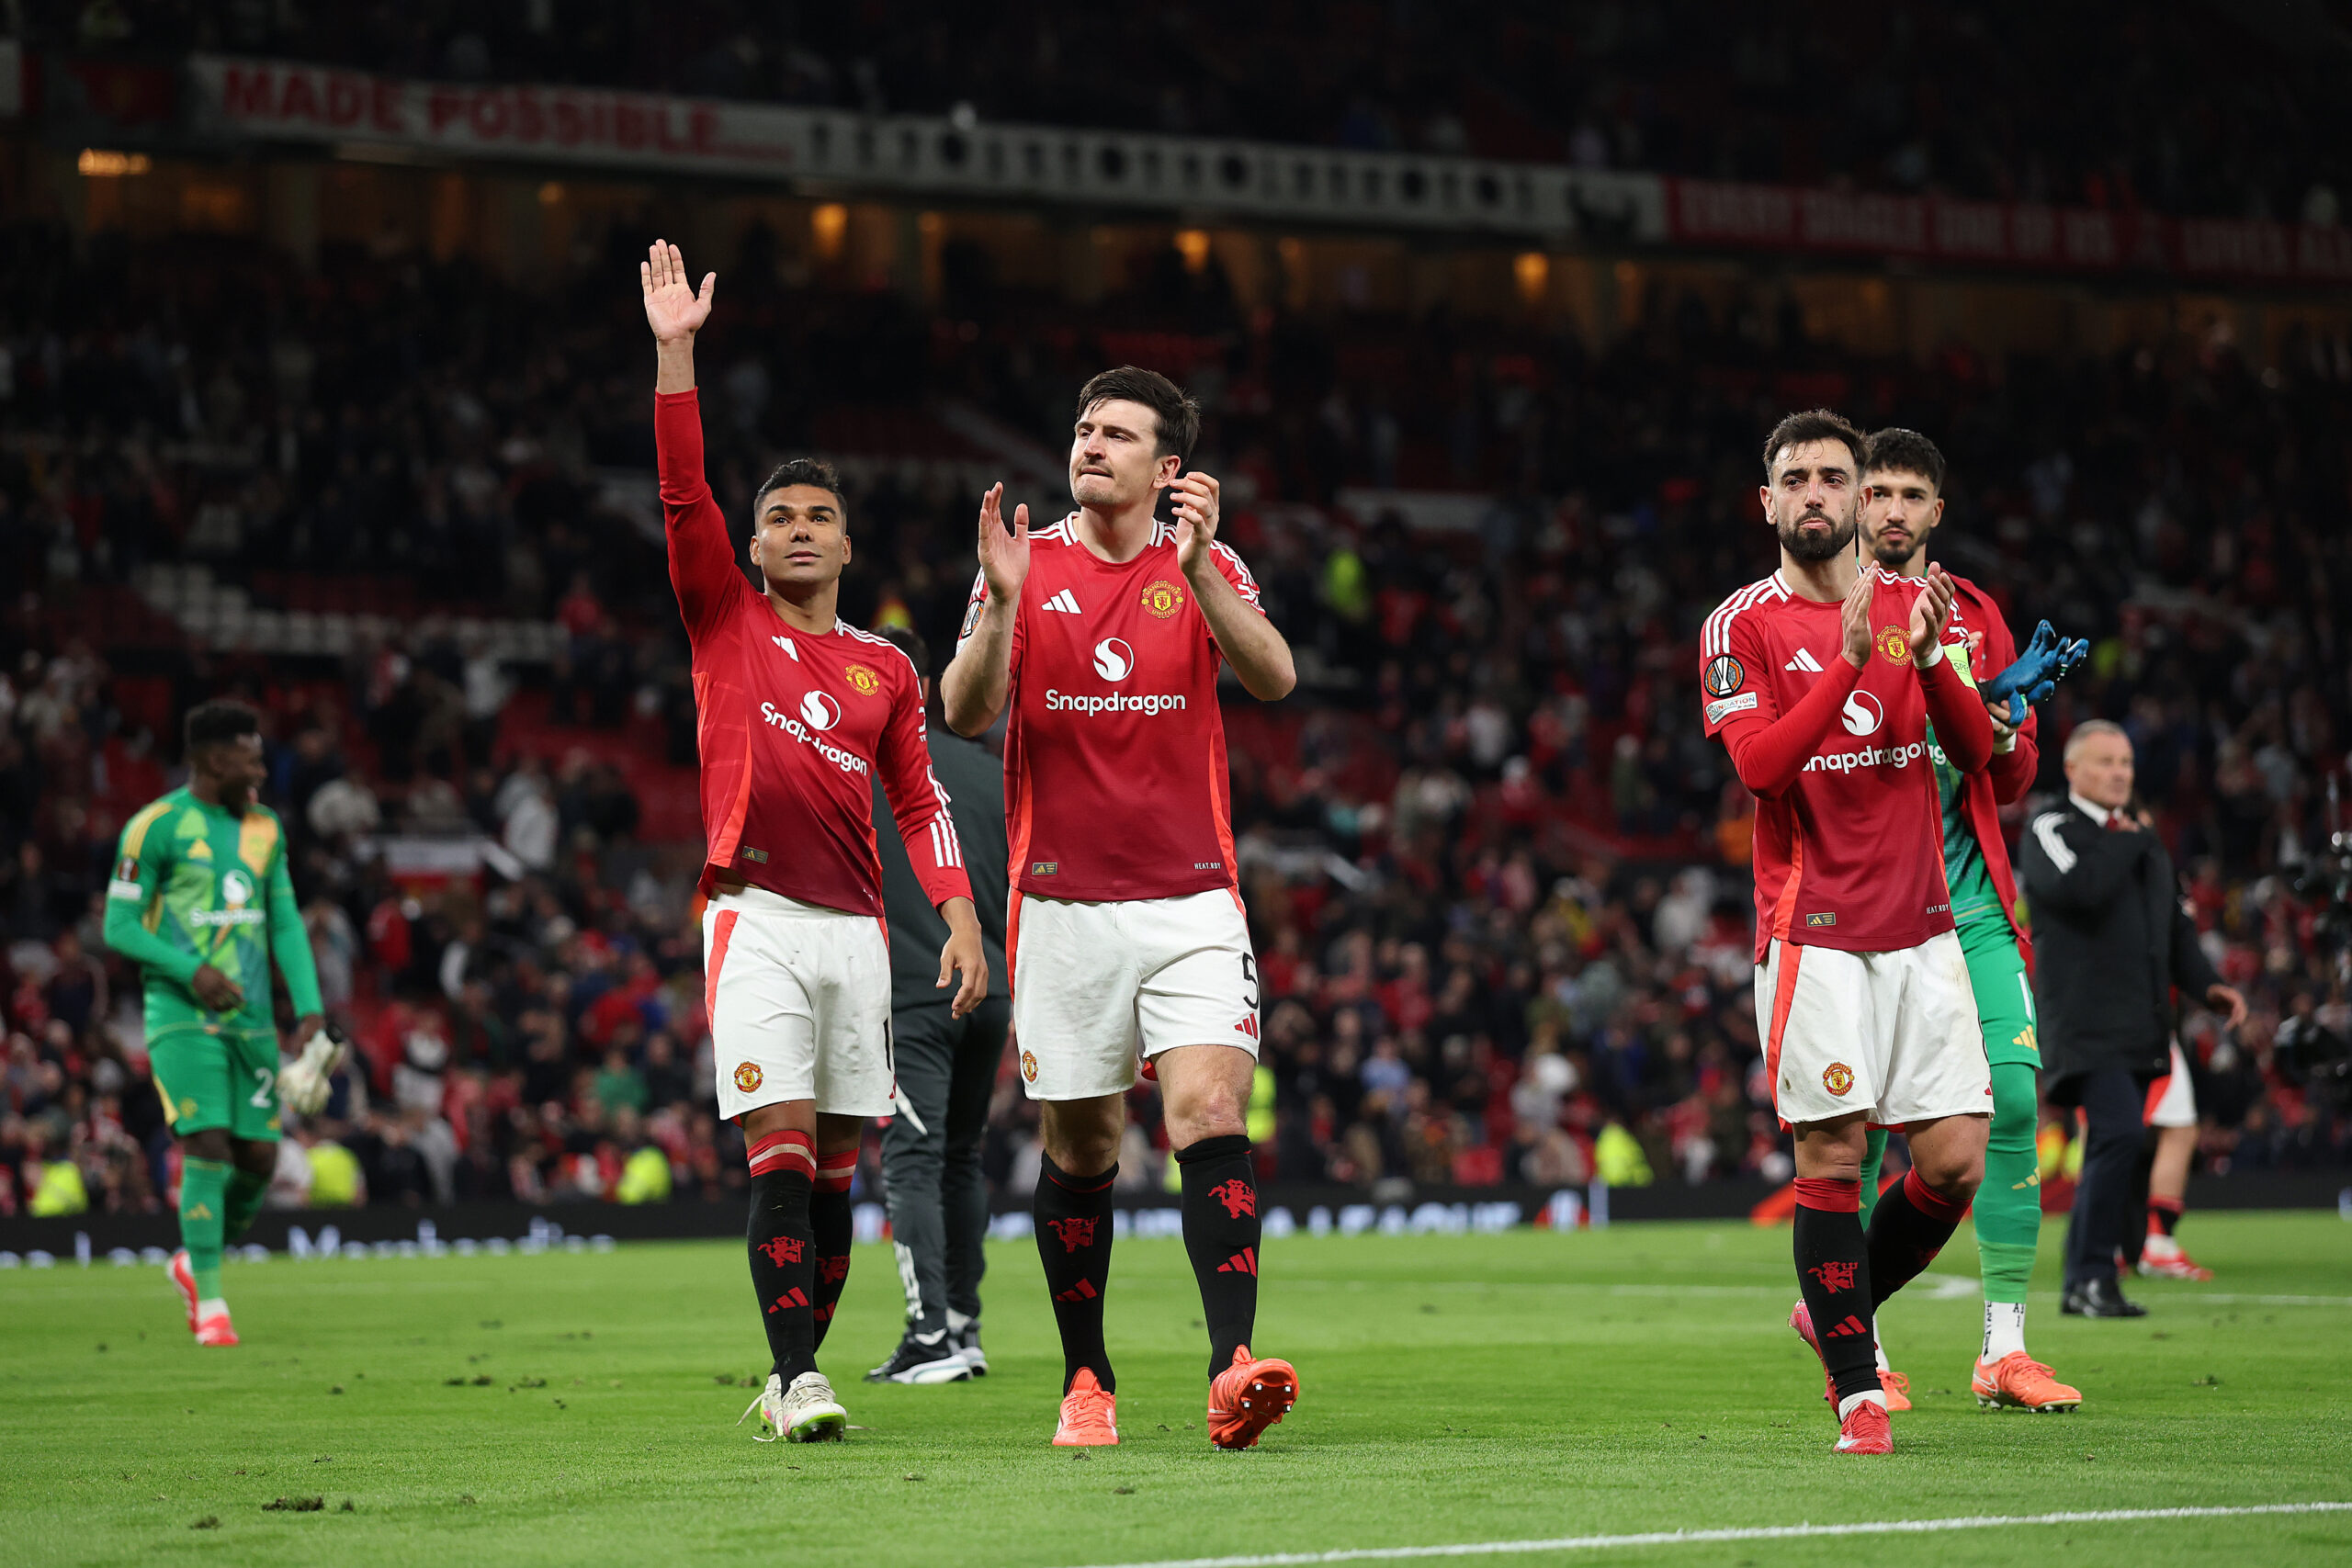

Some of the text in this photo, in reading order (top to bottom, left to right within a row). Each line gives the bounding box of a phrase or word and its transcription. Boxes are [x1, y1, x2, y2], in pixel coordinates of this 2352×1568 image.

[225, 66, 404, 130] MADE
[1146, 583, 1180, 596] MANCHESTER
[1152, 608, 1176, 616] UNITED
[1046, 689, 1186, 716] Snapdragon
[1708, 696, 1755, 717] FOUNDATION
[1242, 951, 1259, 1010] 5
[250, 1067, 275, 1108] 2
